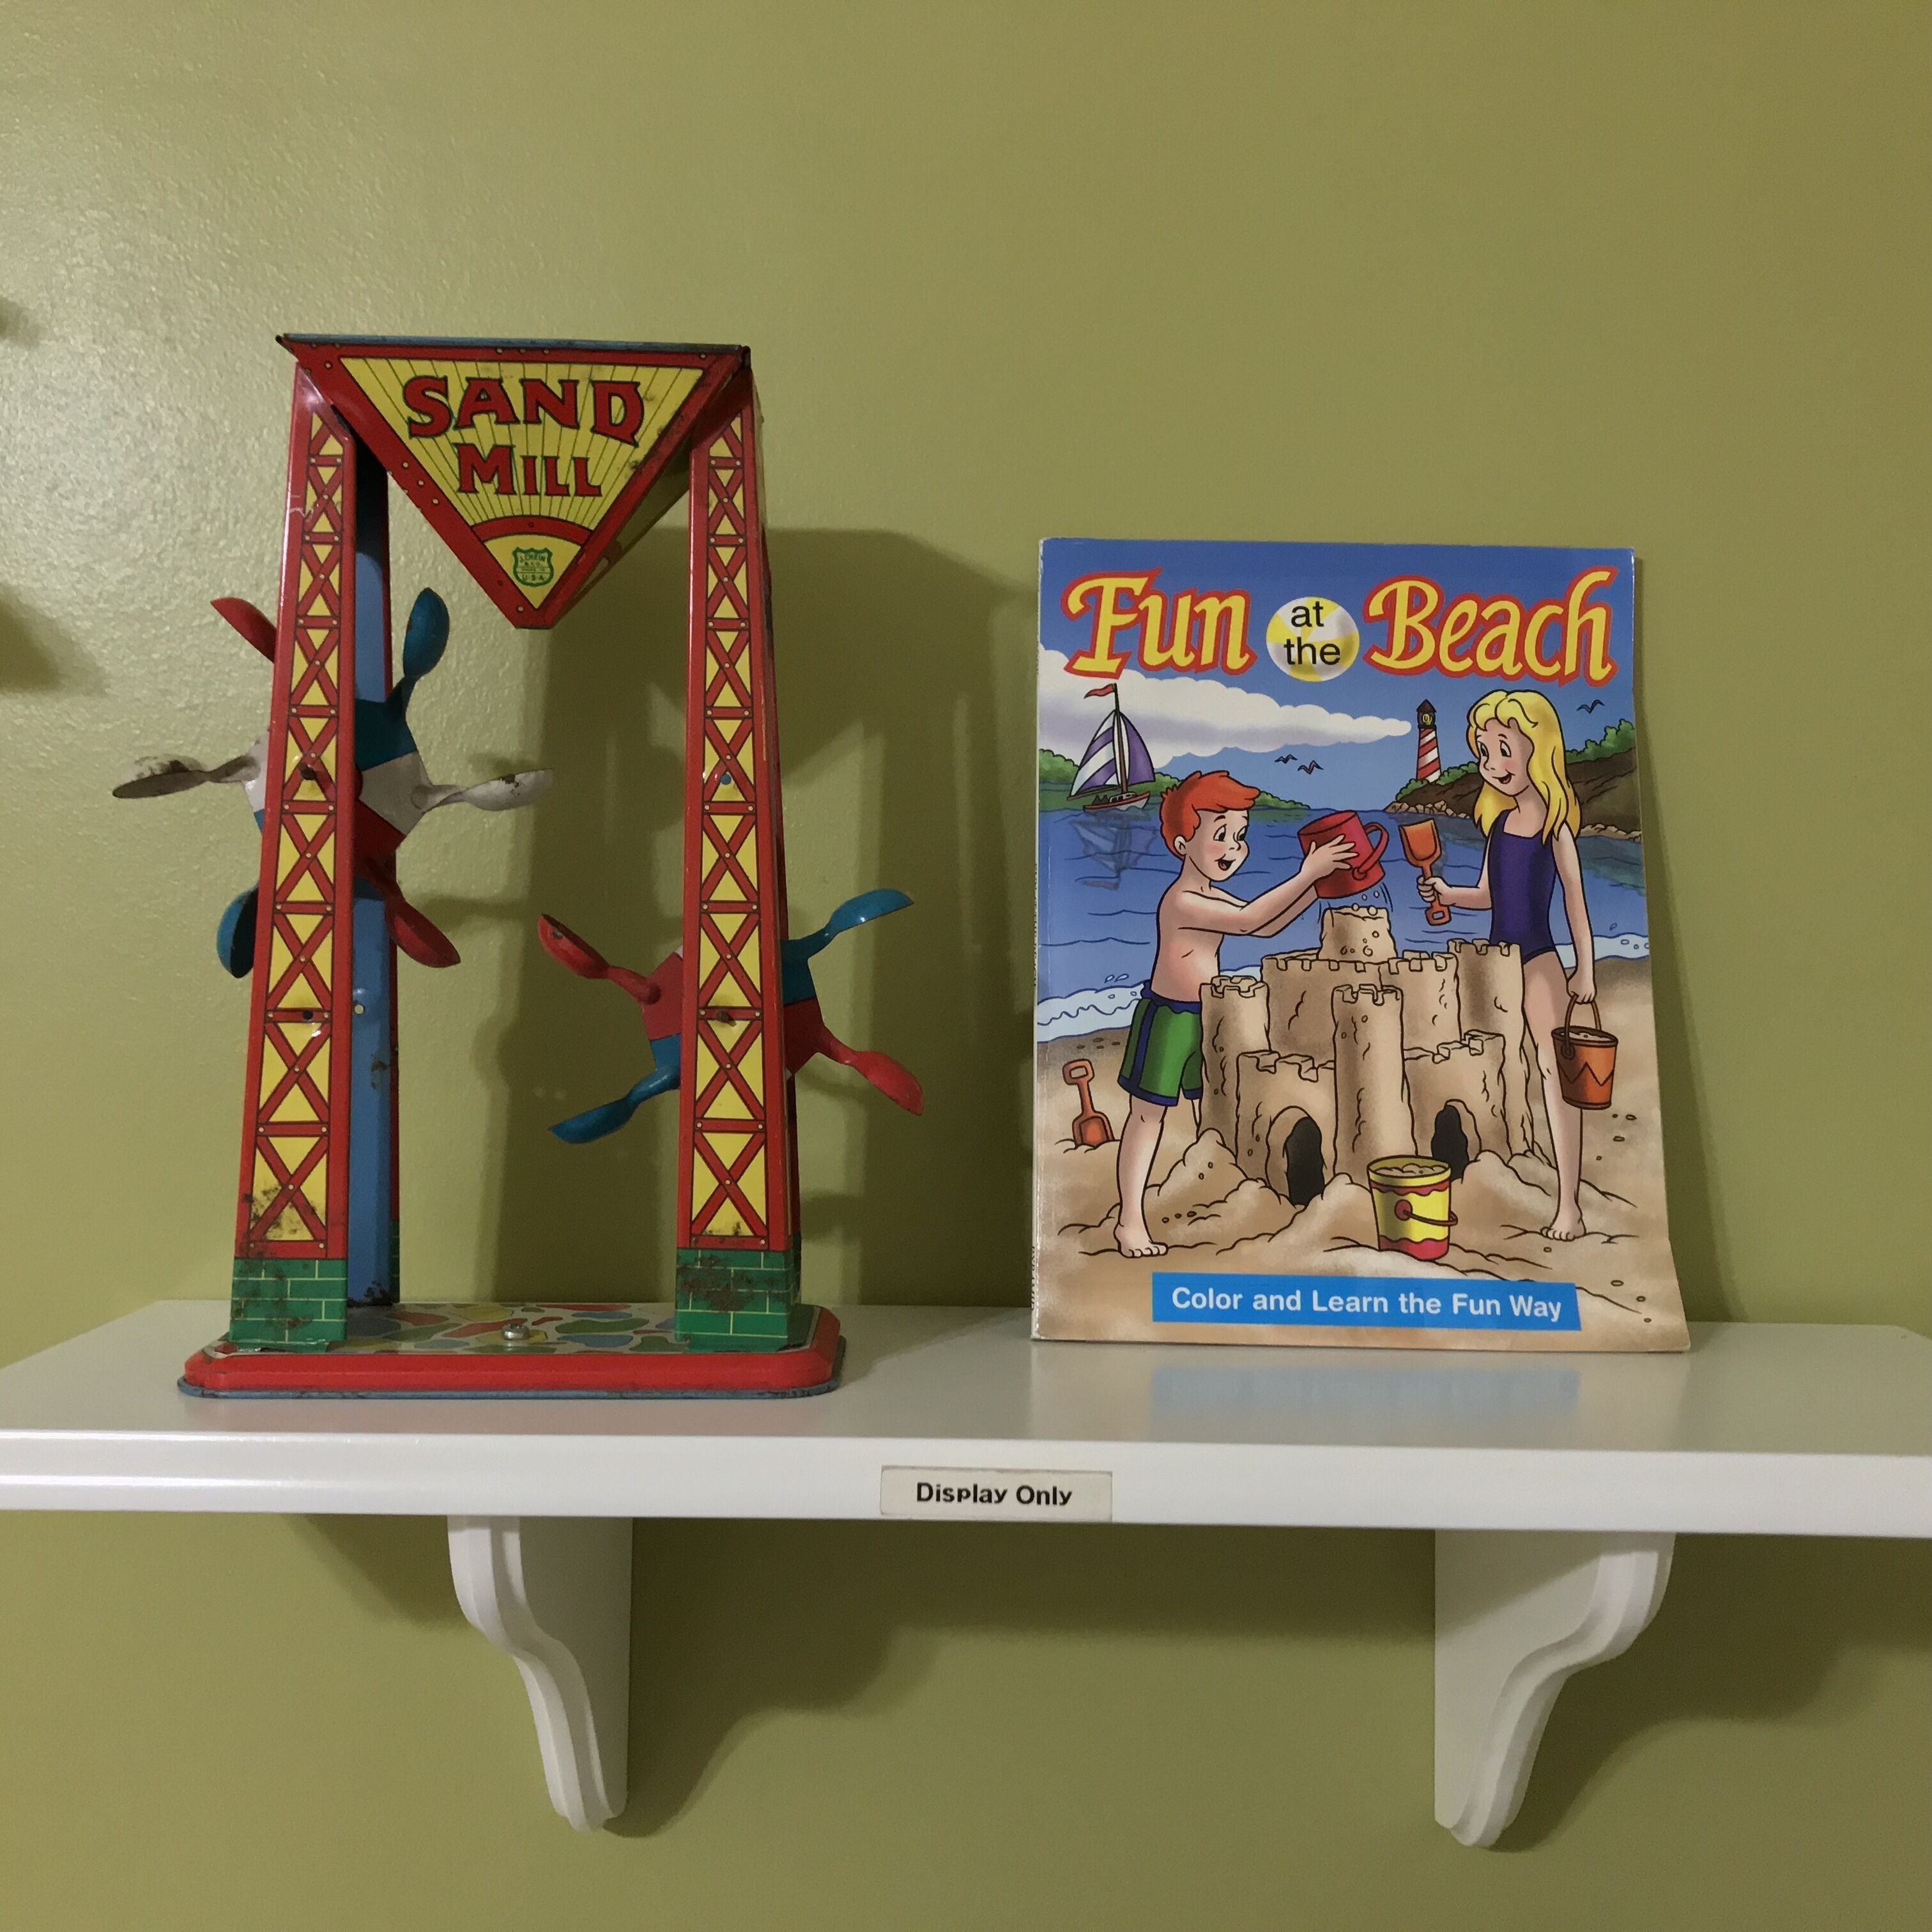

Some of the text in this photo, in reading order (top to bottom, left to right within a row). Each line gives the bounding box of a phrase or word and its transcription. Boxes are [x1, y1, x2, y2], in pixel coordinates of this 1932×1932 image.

[402, 376, 645, 447] SAND
[454, 443, 602, 497] MILL
[1062, 567, 1257, 680] Fun
[1291, 601, 1324, 627] at
[1363, 566, 1618, 687] Beach
[1284, 637, 1341, 666] the
[1171, 1286, 1561, 1322] Color and Learn the Fun Way
[917, 1482, 1073, 1506] Display Only
